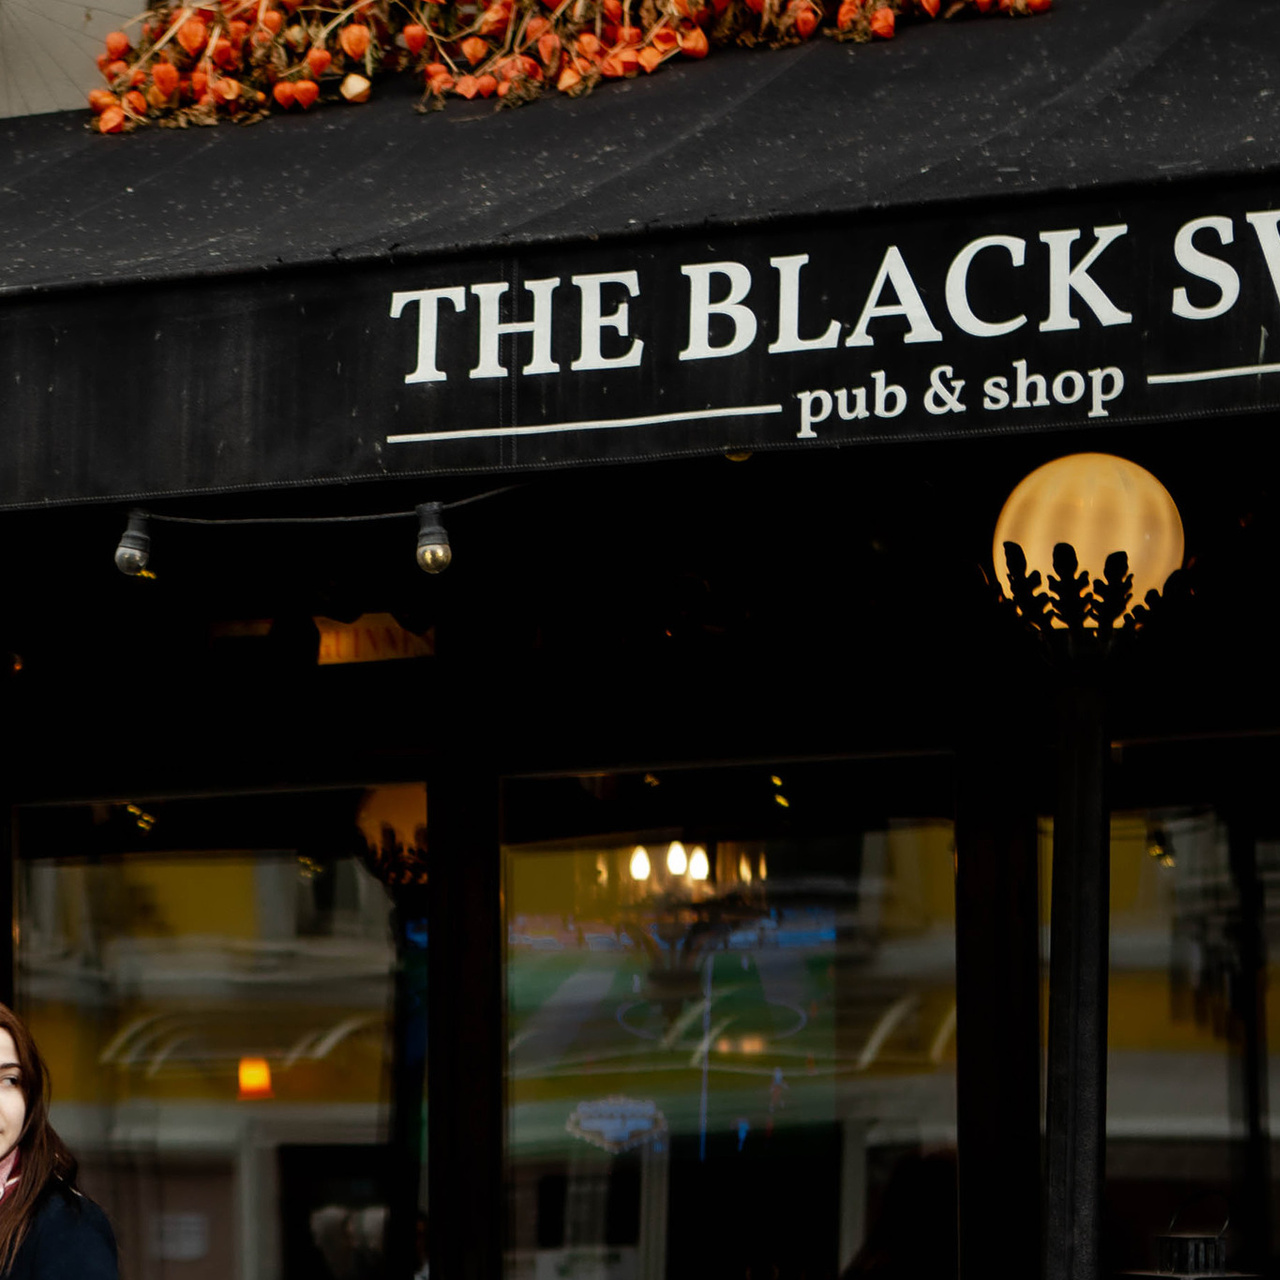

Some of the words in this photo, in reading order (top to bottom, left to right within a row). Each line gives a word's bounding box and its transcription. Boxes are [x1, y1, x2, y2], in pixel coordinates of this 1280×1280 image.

[389, 270, 645, 385] THE
[678, 223, 1133, 361] BLACK
[796, 369, 908, 439] pub
[923, 365, 967, 415] &
[983, 358, 1125, 418] shop
[321, 626, 435, 659] GUINN
